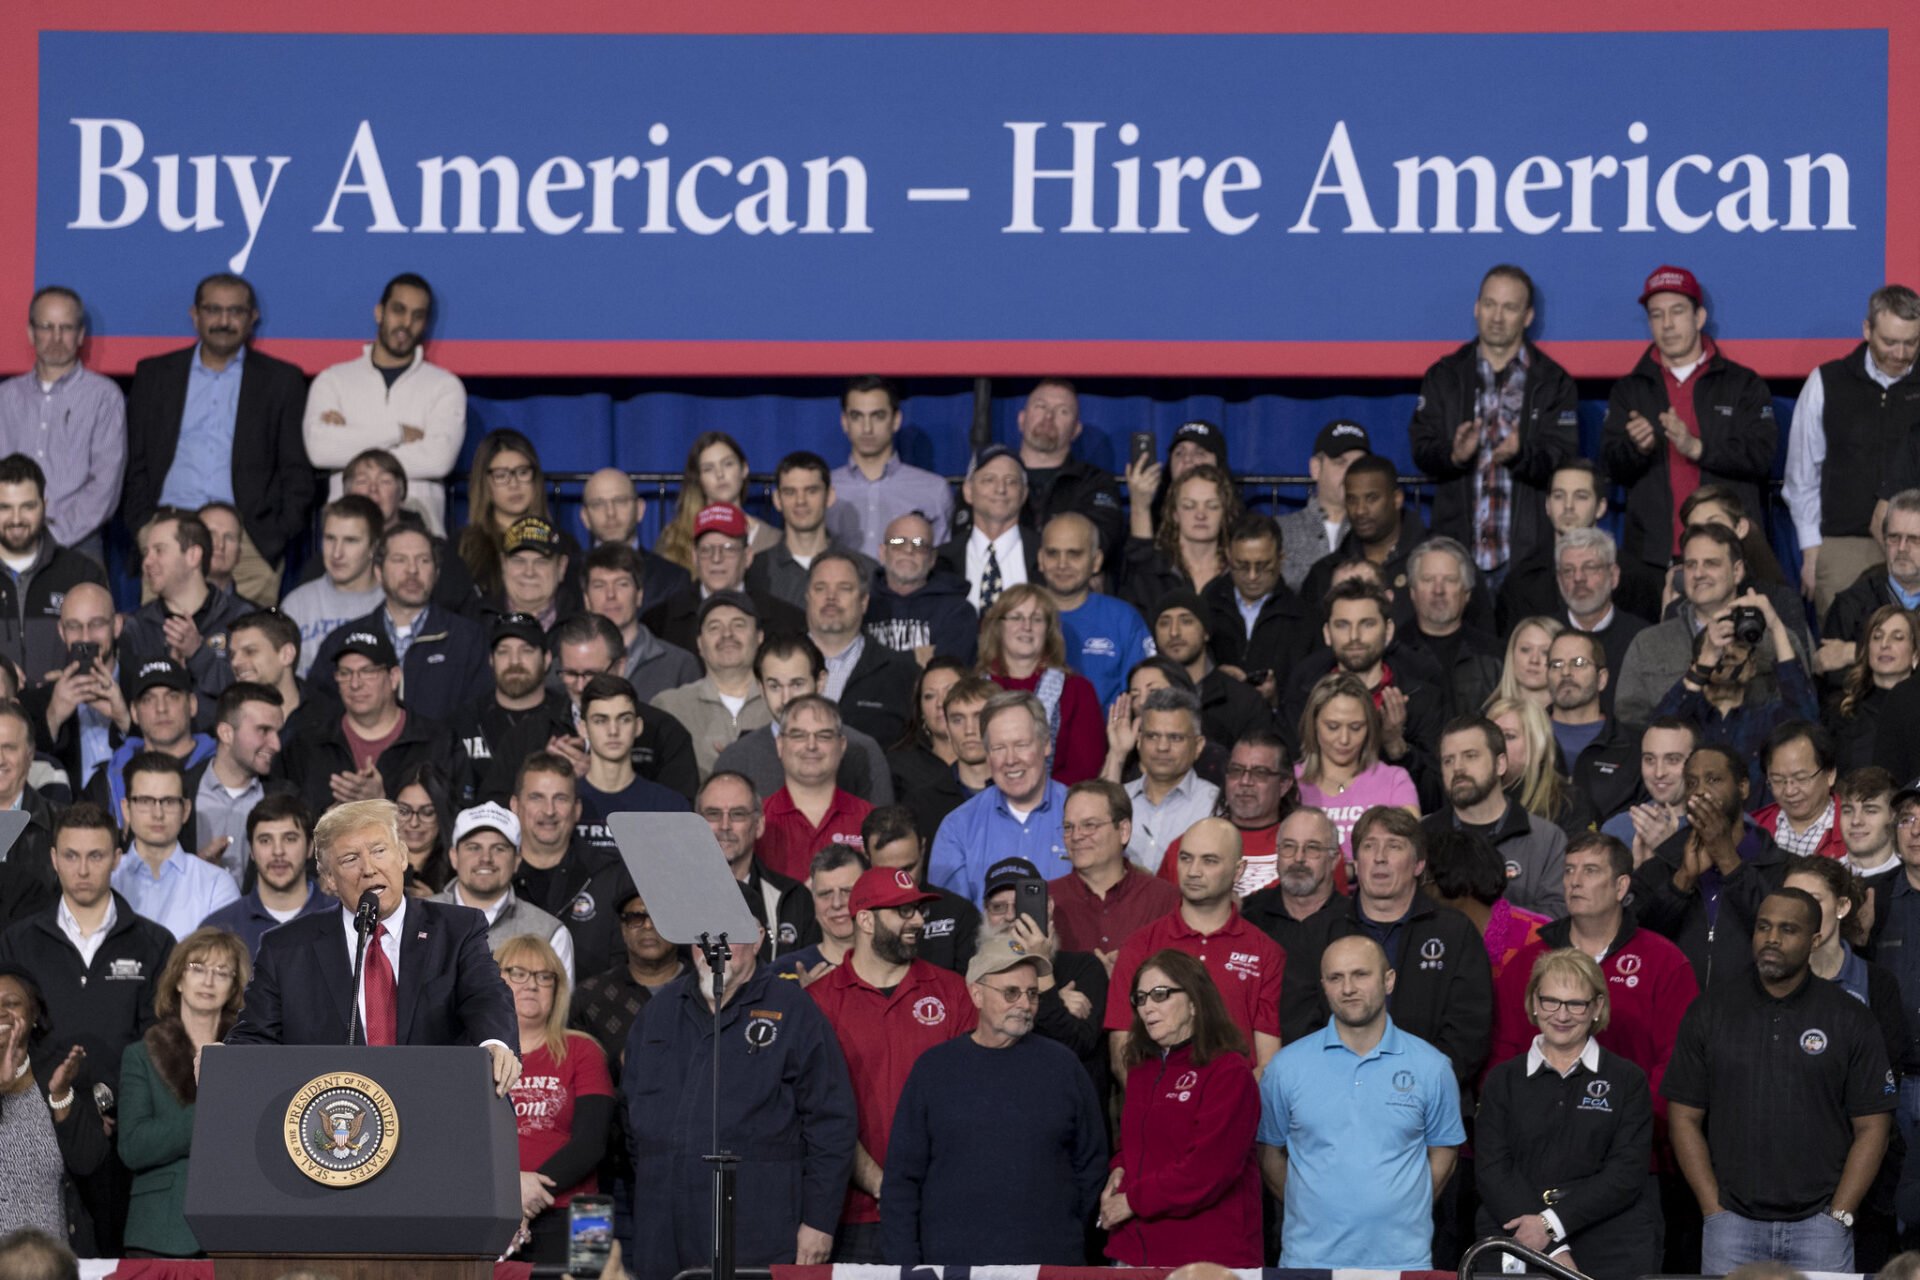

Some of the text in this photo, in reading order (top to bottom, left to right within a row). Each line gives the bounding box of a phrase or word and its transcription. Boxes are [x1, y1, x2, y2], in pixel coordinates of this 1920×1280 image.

[67, 118, 291, 274] Buy
[312, 120, 874, 235] American
[1001, 121, 1261, 235] Hire
[1287, 120, 1857, 235] American
[288, 1076, 395, 1180] SEAL OF THE PRESIDENT OF THE UNITED STATES
[513, 1099, 548, 1117] om
